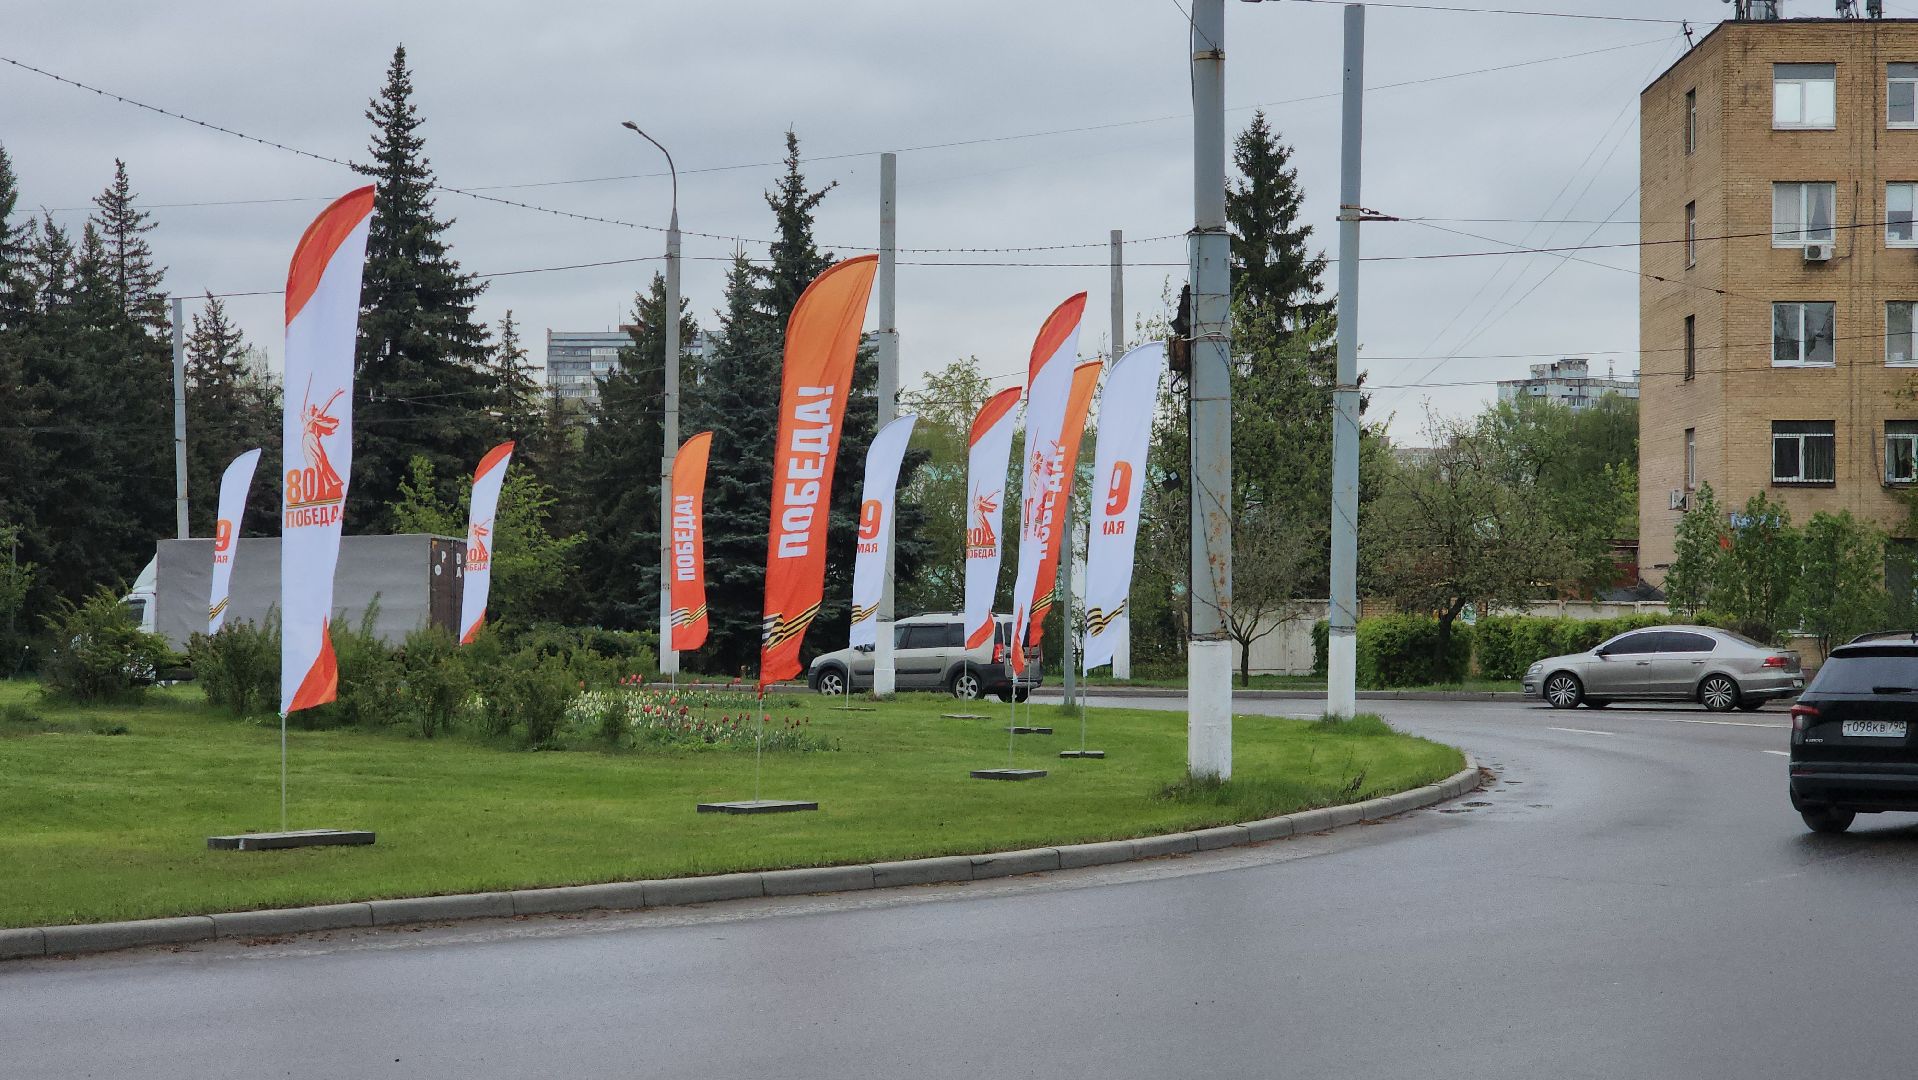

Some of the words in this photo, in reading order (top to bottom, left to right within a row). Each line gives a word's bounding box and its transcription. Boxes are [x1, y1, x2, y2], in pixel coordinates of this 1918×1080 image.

[286, 468, 316, 503] 80
[778, 384, 835, 559] ПОБЕДА!
[1105, 461, 1133, 516] 9
[216, 519, 232, 552] 9
[673, 495, 697, 581] ПОБЕДА!
[859, 499, 882, 540] 9
[213, 555, 228, 564] АЯ
[857, 543, 879, 553] МАЯ
